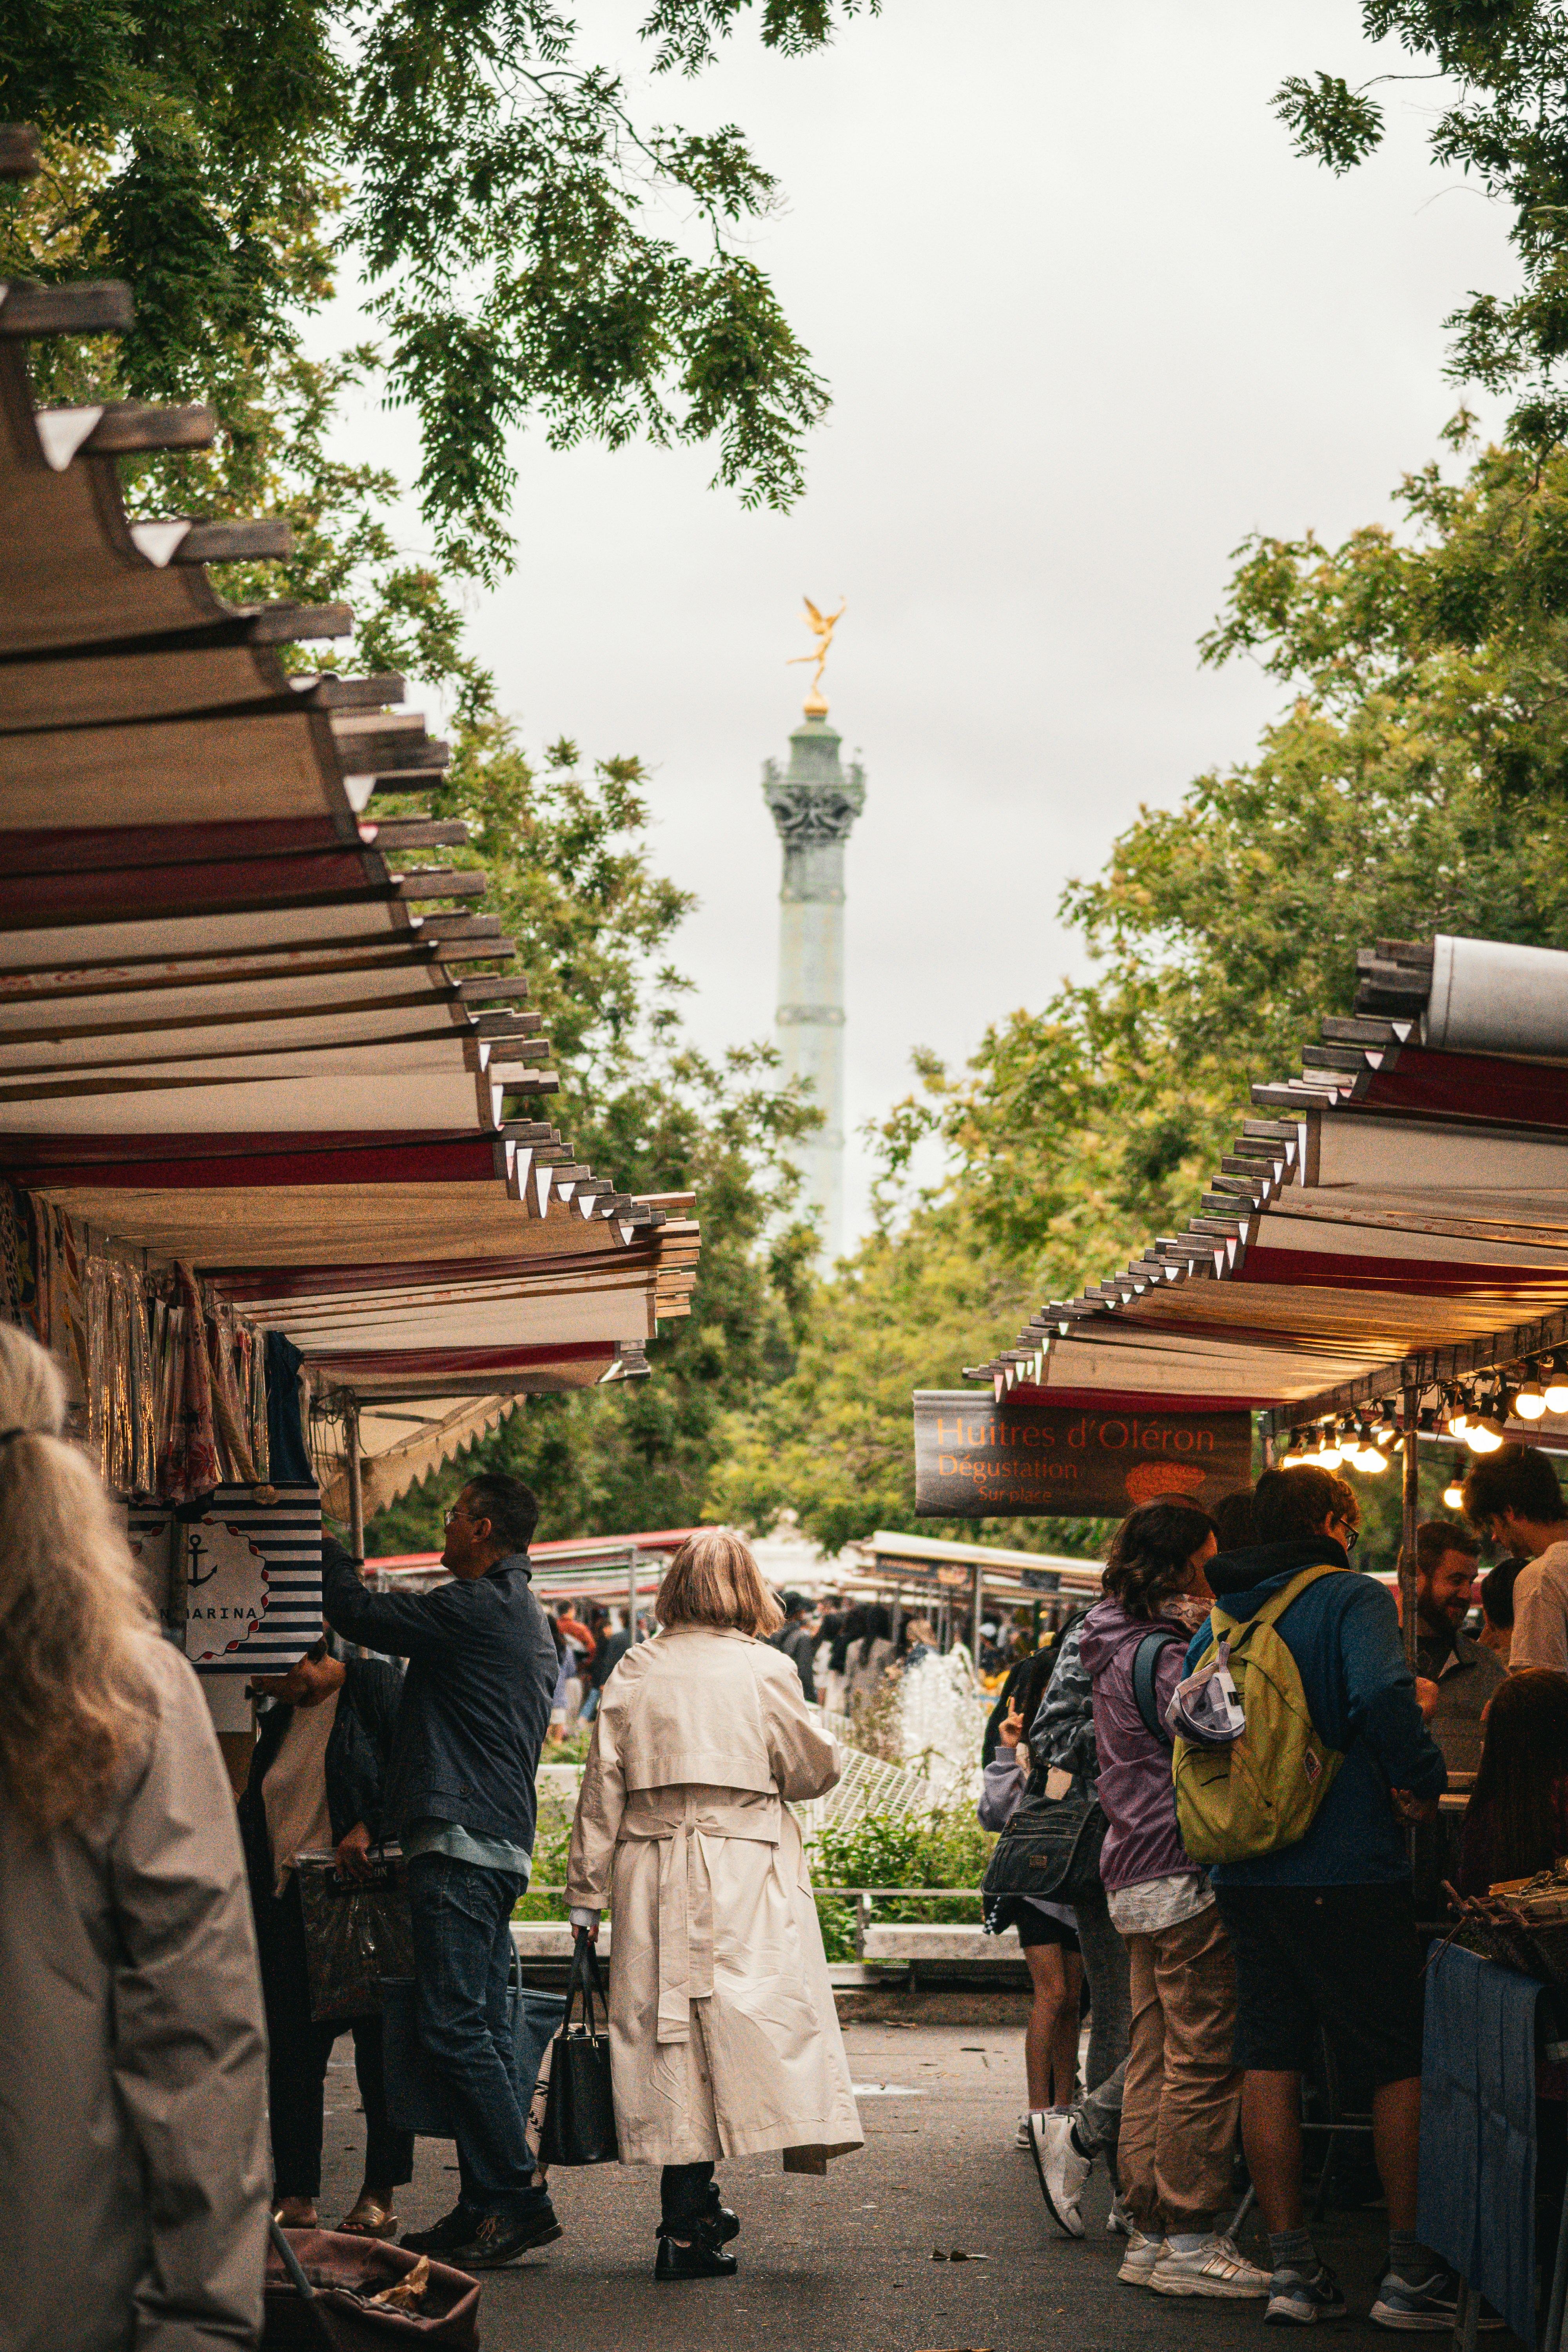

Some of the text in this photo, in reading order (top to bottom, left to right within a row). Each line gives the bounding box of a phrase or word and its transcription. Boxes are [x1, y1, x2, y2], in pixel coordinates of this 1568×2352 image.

[937, 1417, 1214, 1450] Huitres d'Oléron
[939, 1454, 1078, 1484] Dégustation
[979, 1485, 1053, 1504] Sur place
[187, 1608, 256, 1619] ARINA
